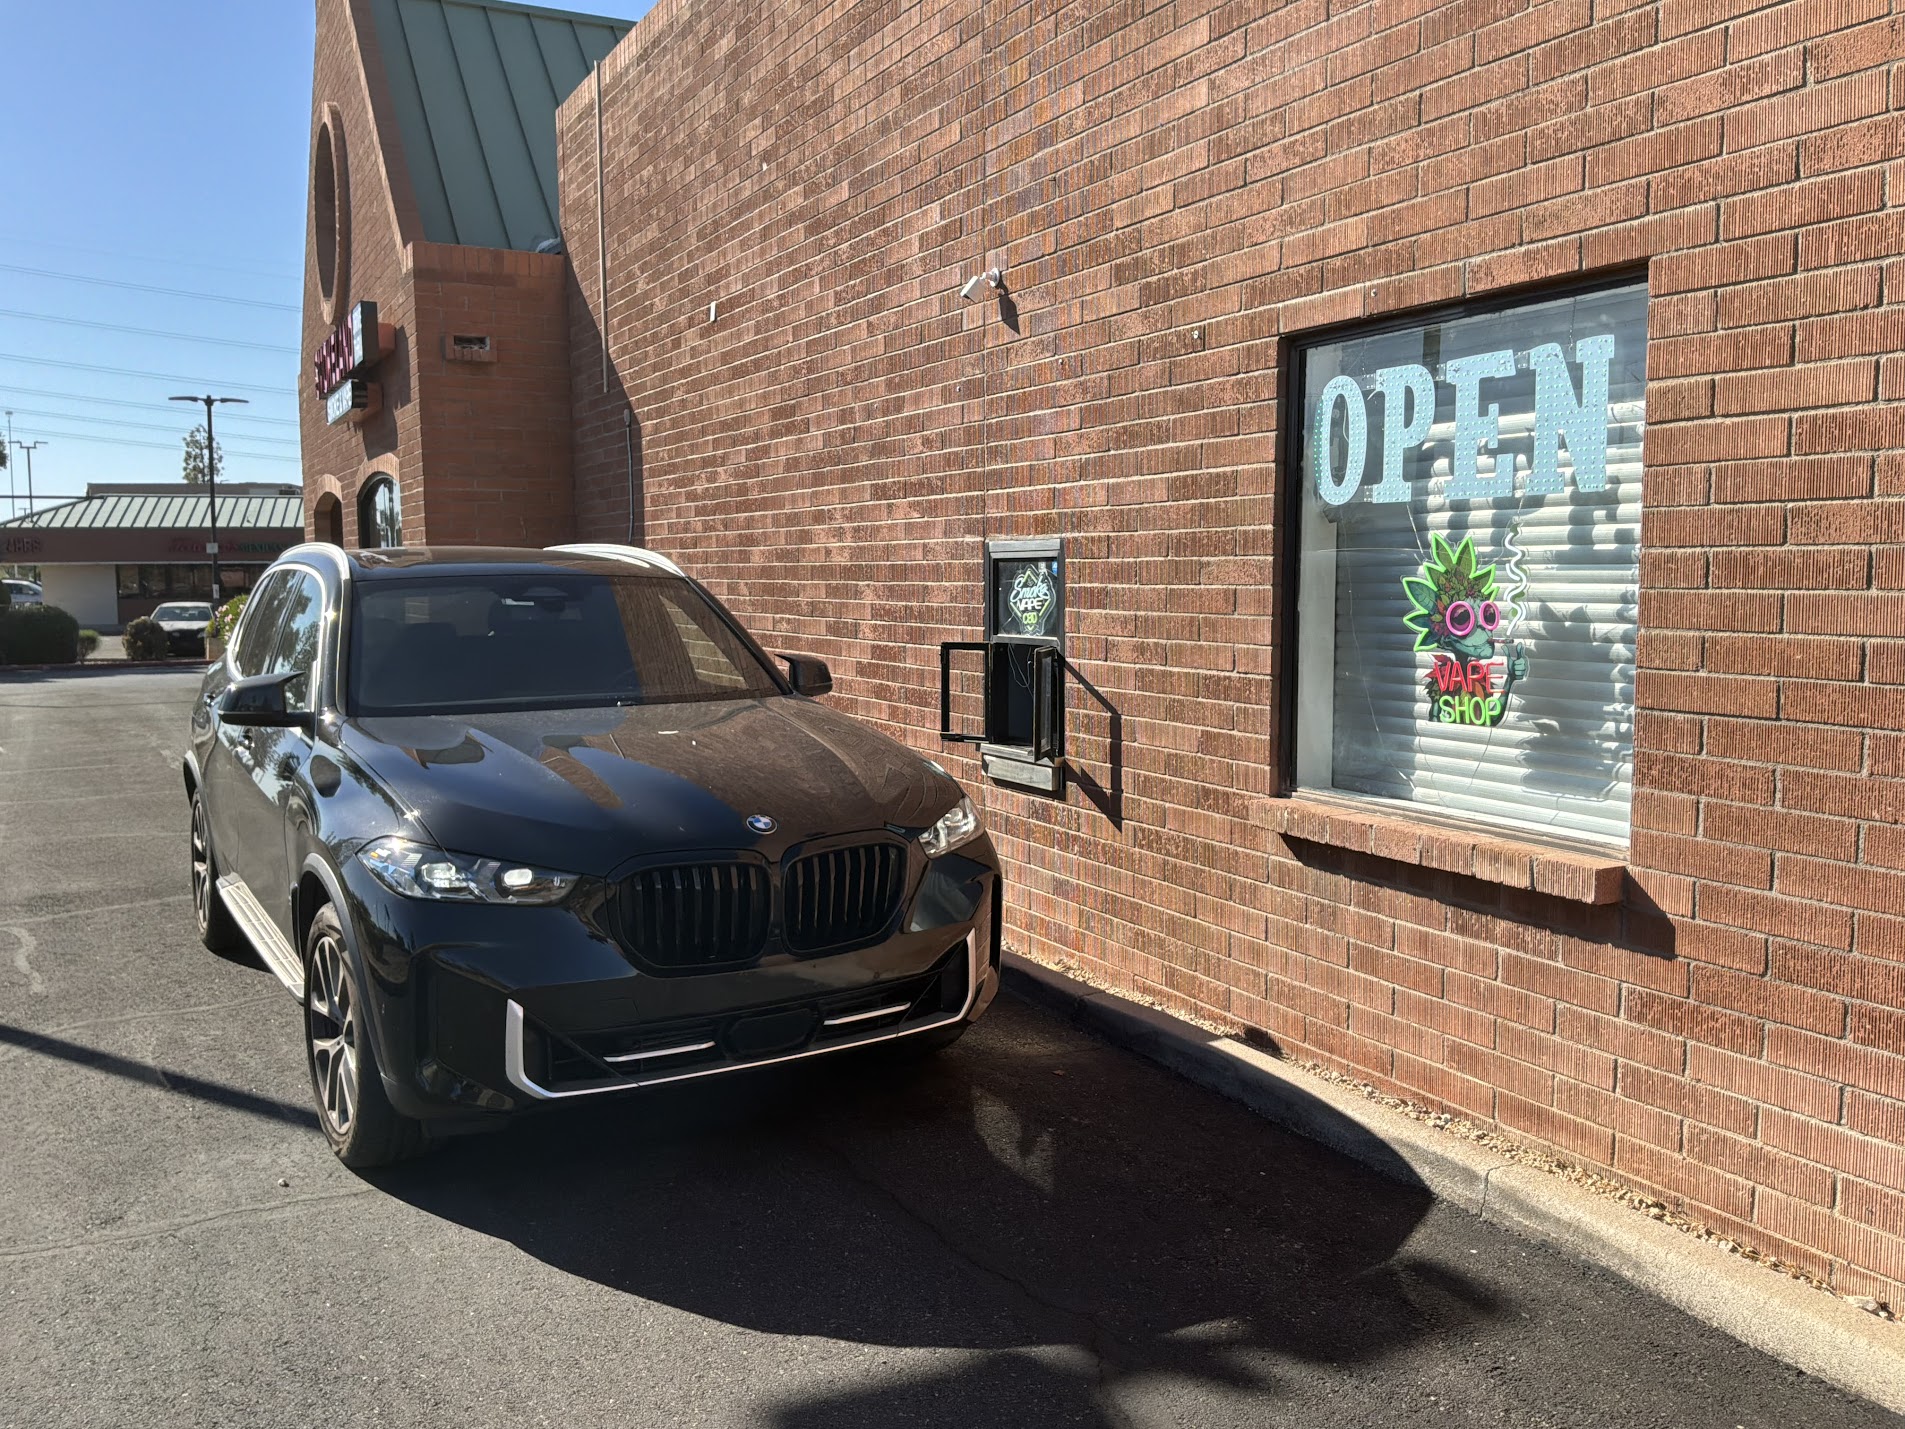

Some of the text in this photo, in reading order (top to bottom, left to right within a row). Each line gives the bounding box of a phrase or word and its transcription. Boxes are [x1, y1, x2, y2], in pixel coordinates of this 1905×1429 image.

[1315, 334, 1615, 506] OPEN
[1017, 598, 1043, 610] VAPE
[1434, 660, 1505, 693] VAPE
[1439, 695, 1501, 726] SHOP
